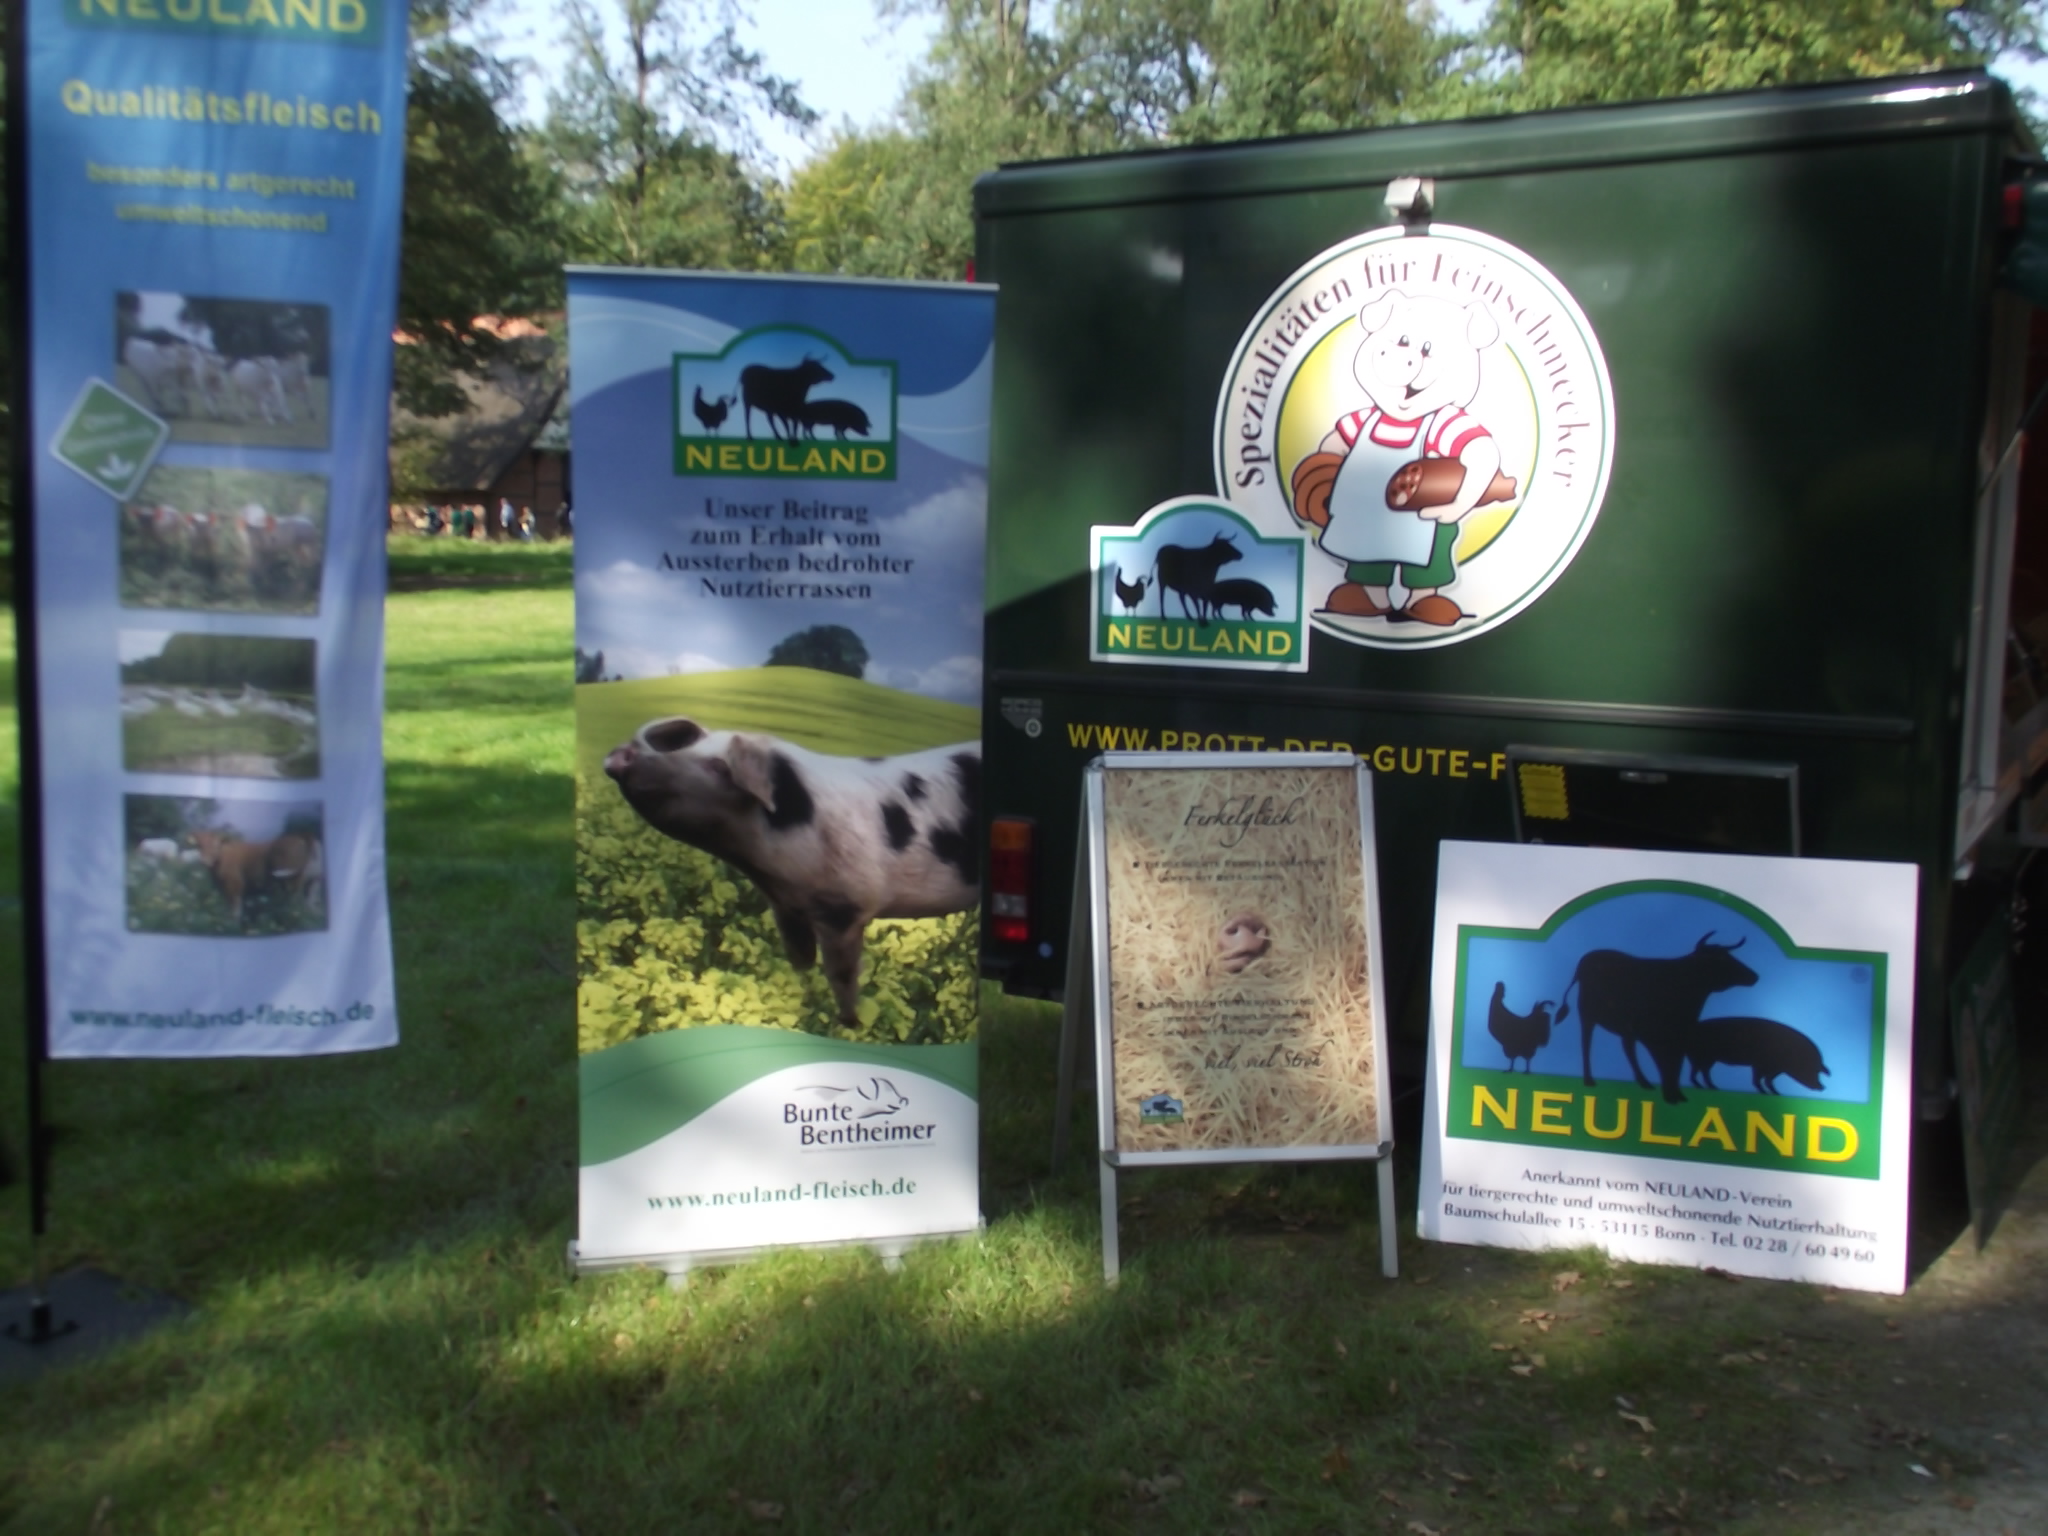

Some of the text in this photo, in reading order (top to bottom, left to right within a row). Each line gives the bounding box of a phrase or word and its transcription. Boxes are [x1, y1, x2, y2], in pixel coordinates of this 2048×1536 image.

[61, 80, 382, 135] Qualitätsfleisch
[225, 171, 356, 199] artgerecht
[1235, 278, 1353, 489] Spezialitäten
[1364, 252, 1417, 289] für
[686, 444, 887, 474] NEULAND
[704, 498, 869, 524] Unser Beitrag
[690, 525, 881, 547] zum Erhalt vom
[658, 552, 915, 575] Aussterben bedrohter
[700, 577, 872, 599] Nutztierrassen
[1107, 623, 1293, 656] NEULAND
[1183, 794, 1306, 849] Ferkelglück
[70, 1001, 375, 1029] www.neuland-fleisch.de
[784, 1102, 854, 1124] Bunte
[1470, 1083, 1860, 1163] NEULAND
[801, 1120, 937, 1146] Bentheimer
[648, 1176, 918, 1211] www.neuland-fleisch.de
[1521, 1168, 1793, 1210] Anerkannt vom NEULAND-Verein
[1442, 1181, 1878, 1243] für tiergerechte und umweltschonende Nutztierhaltung
[1444, 1202, 1562, 1229] Baumschulallee
[1568, 1216, 1586, 1231] 15
[1601, 1219, 1650, 1238] 53115
[1654, 1225, 1697, 1243] Bonn
[1711, 1231, 1738, 1248] Tel.
[1743, 1236, 1764, 1252] 02
[1767, 1239, 1788, 1254] 28
